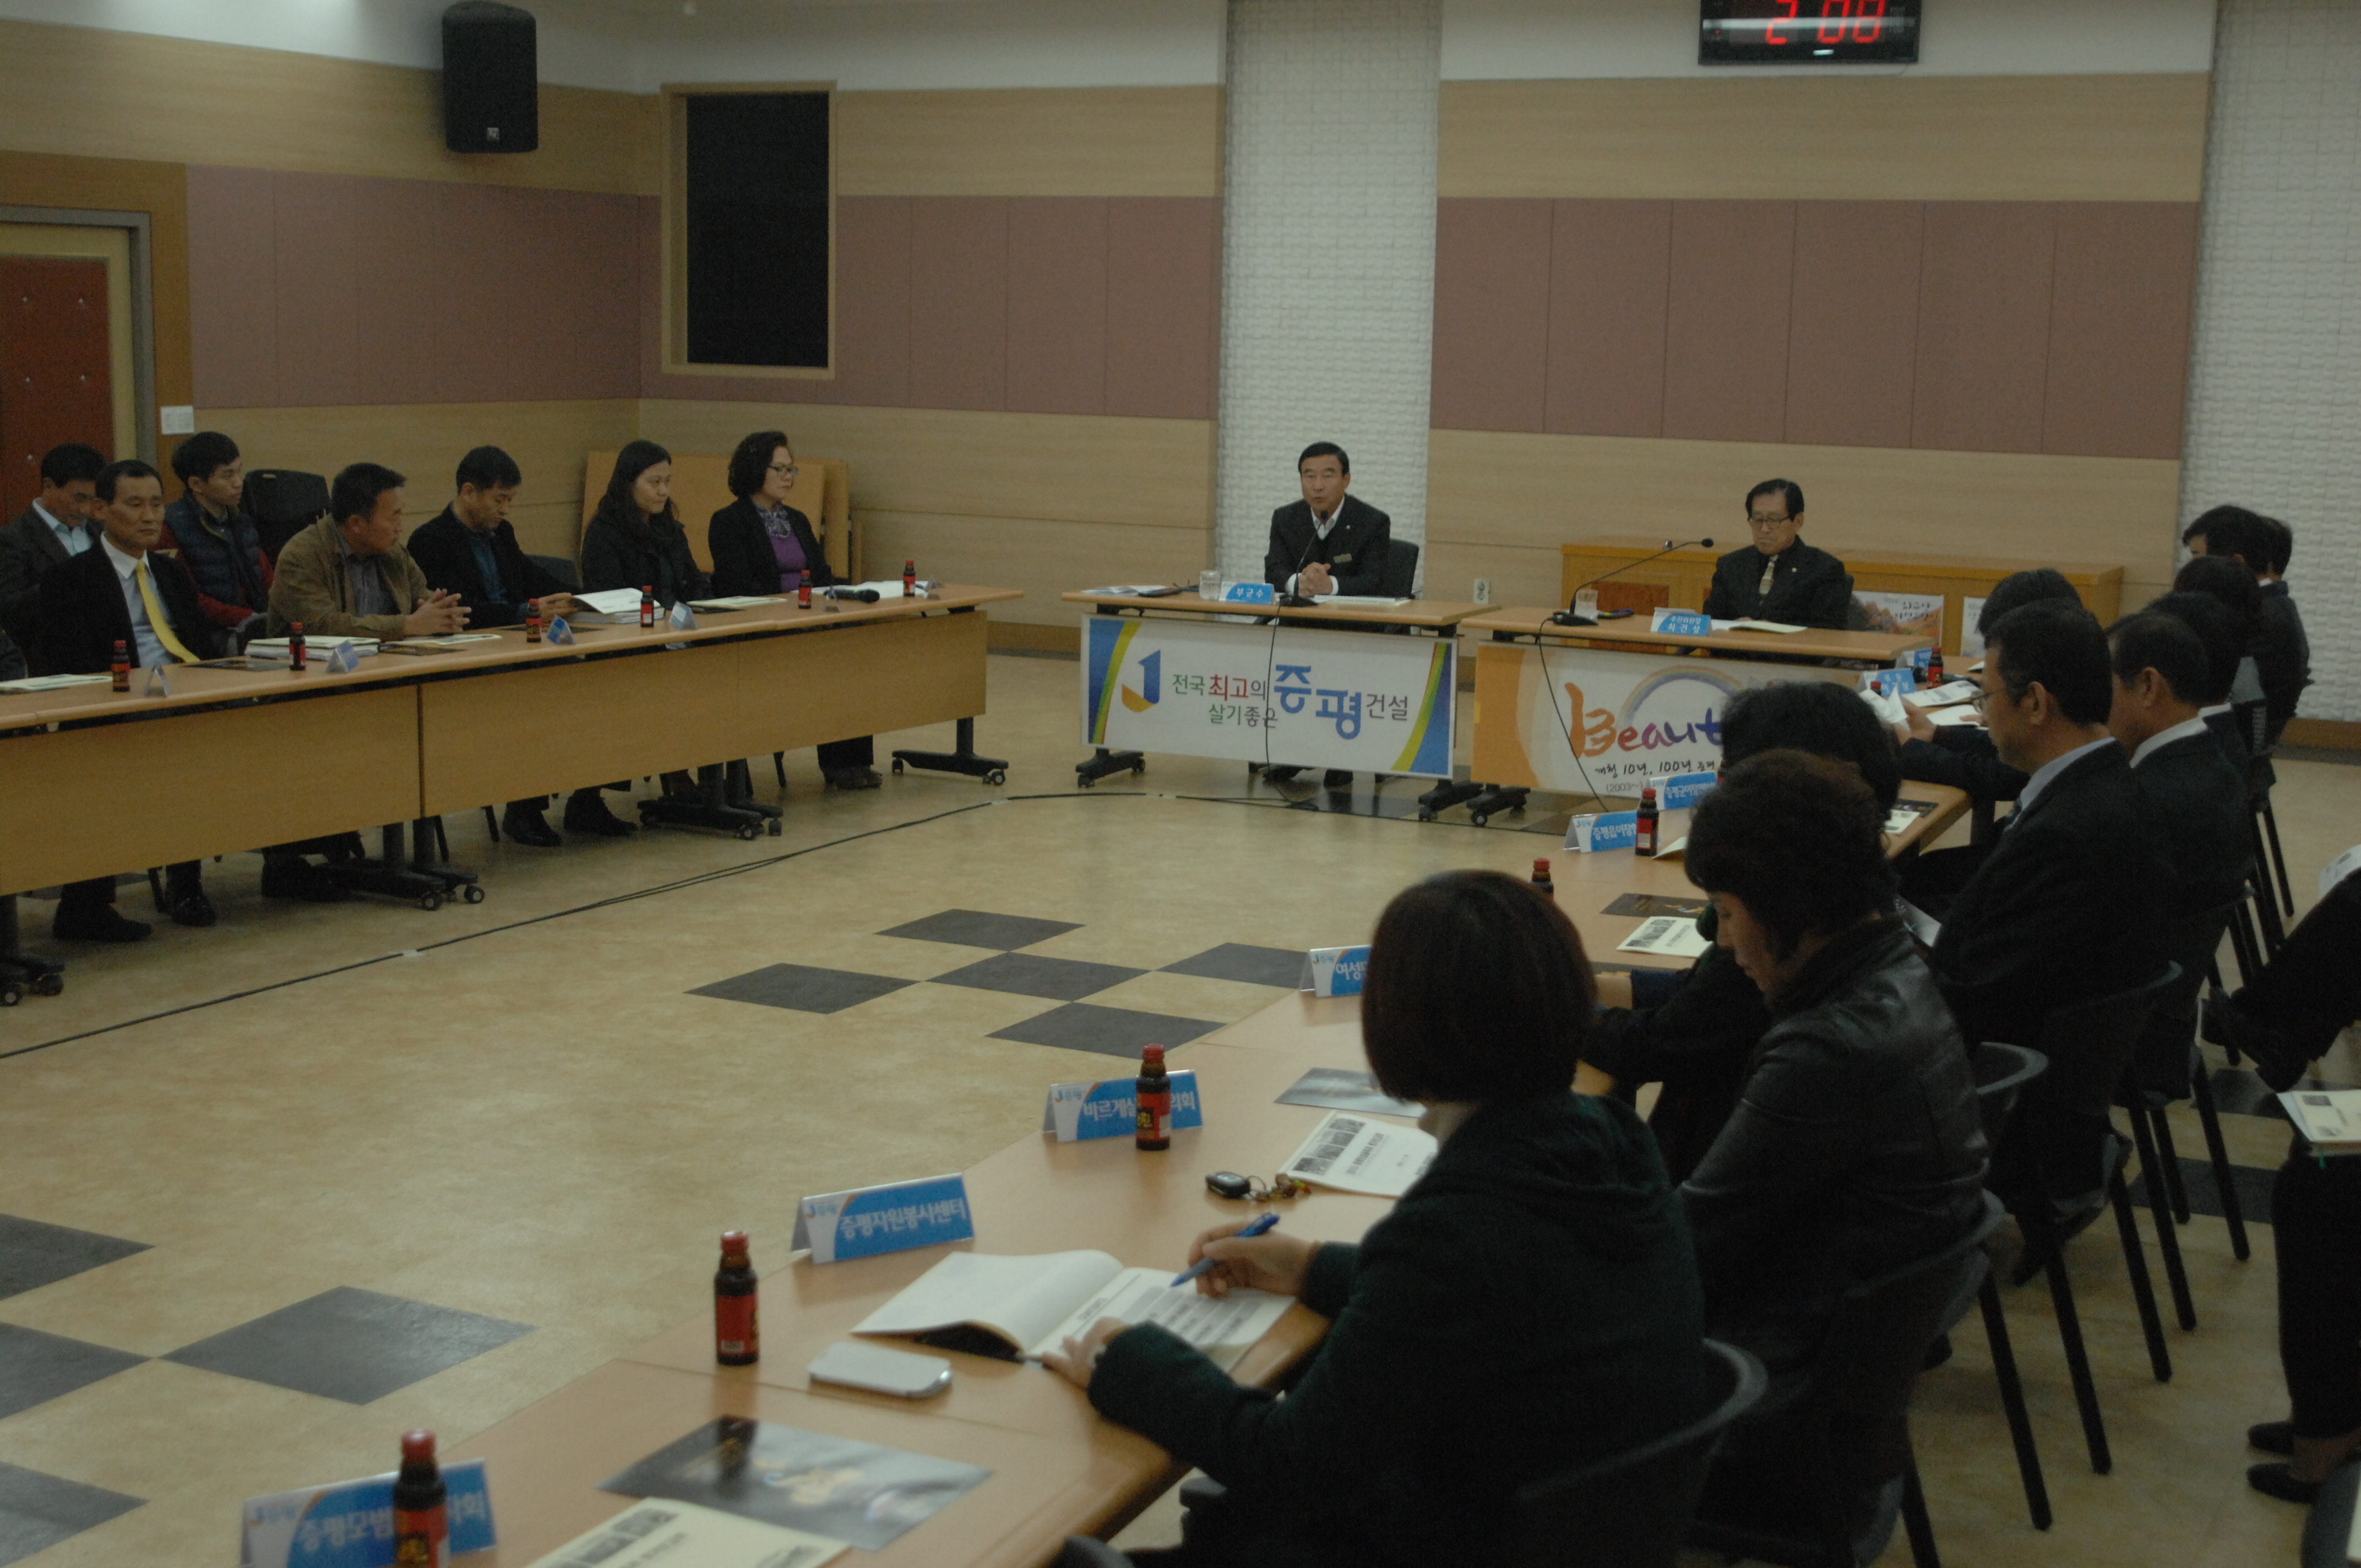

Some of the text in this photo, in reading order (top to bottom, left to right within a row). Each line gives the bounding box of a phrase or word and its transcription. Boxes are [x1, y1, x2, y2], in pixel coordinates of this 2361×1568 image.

[1274, 663, 1408, 740] 증평 건설
[1564, 681, 1724, 759] Beaut
